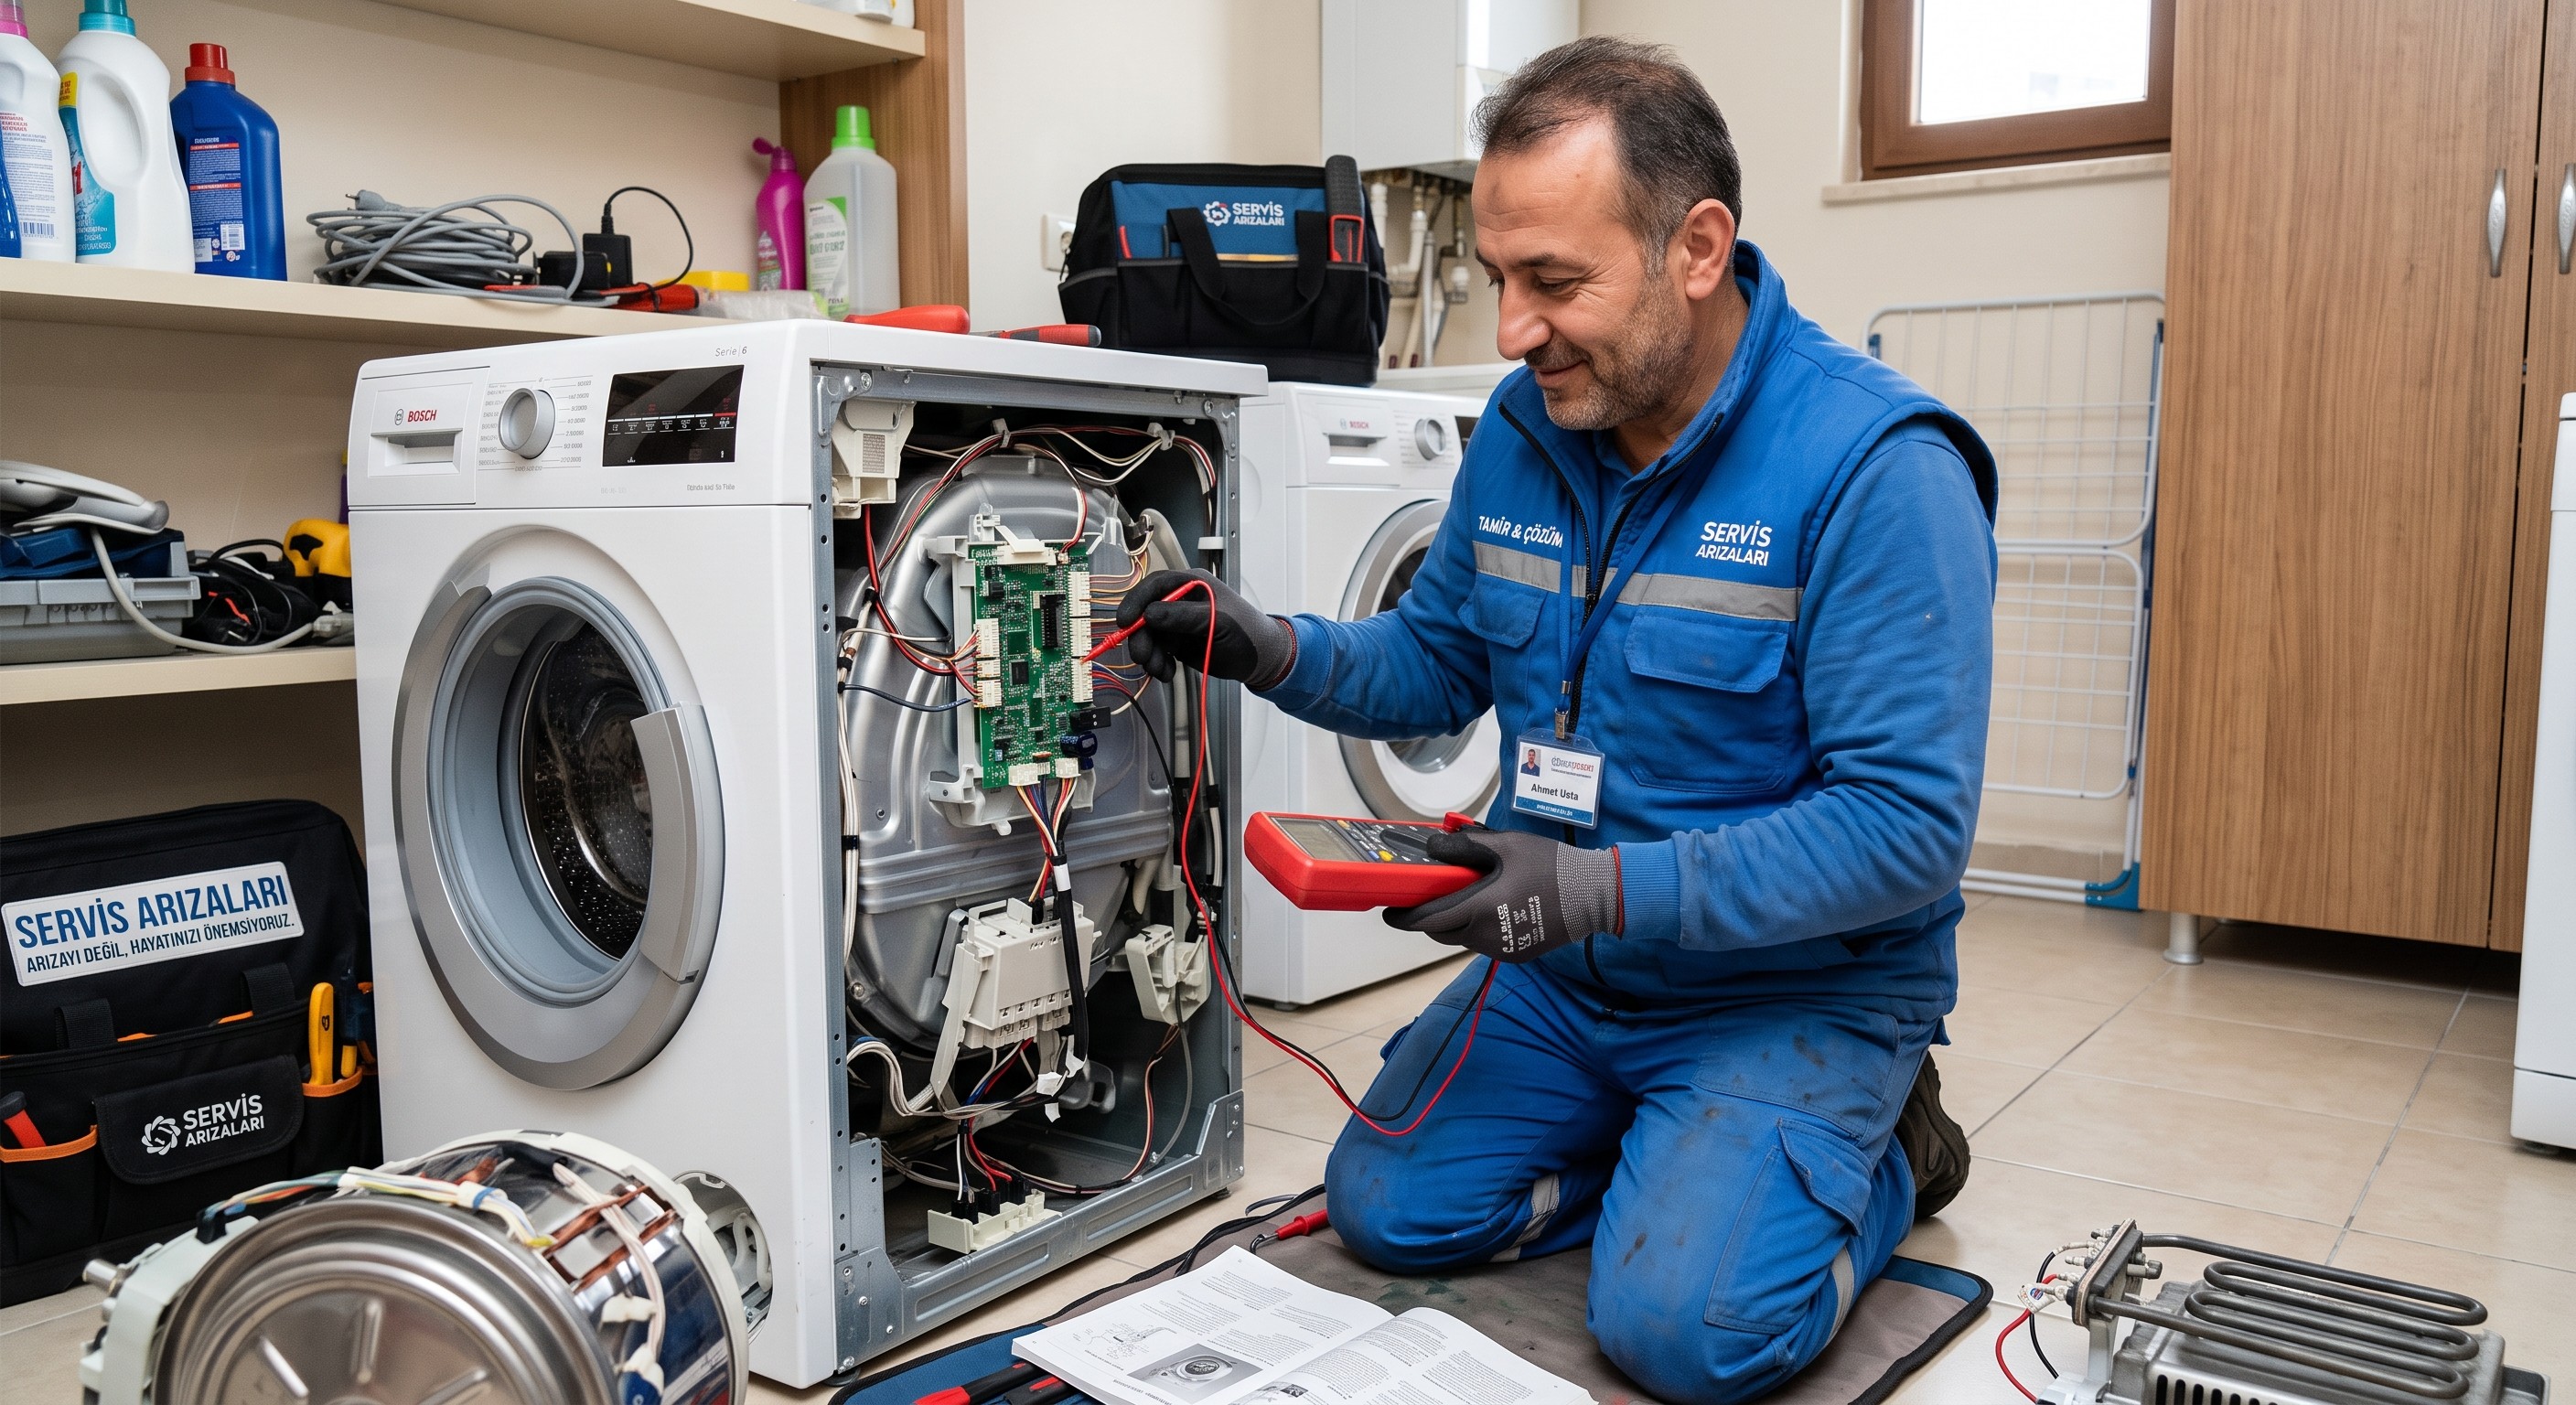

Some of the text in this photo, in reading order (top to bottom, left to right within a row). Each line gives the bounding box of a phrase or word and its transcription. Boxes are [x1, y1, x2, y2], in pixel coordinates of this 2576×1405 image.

[1232, 200, 1284, 217] SERVİS
[714, 346, 747, 357] Serie 6
[407, 409, 437, 423] BOSCH
[1478, 515, 1564, 549] TAMİR & ÇÖZÜM
[1700, 520, 1773, 548] SERVİS
[1695, 543, 1769, 567] ARIZALARI
[1530, 783, 1579, 801] Ahmet Usta
[15, 874, 289, 949] SERVİS ARIZALARI
[27, 913, 295, 973] ARIZAYI DEĞİL, HAYATINIZI ÖNEMSİYORUZ.
[183, 1092, 263, 1131] SERVİS
[185, 1115, 265, 1147] ARIZALARI
